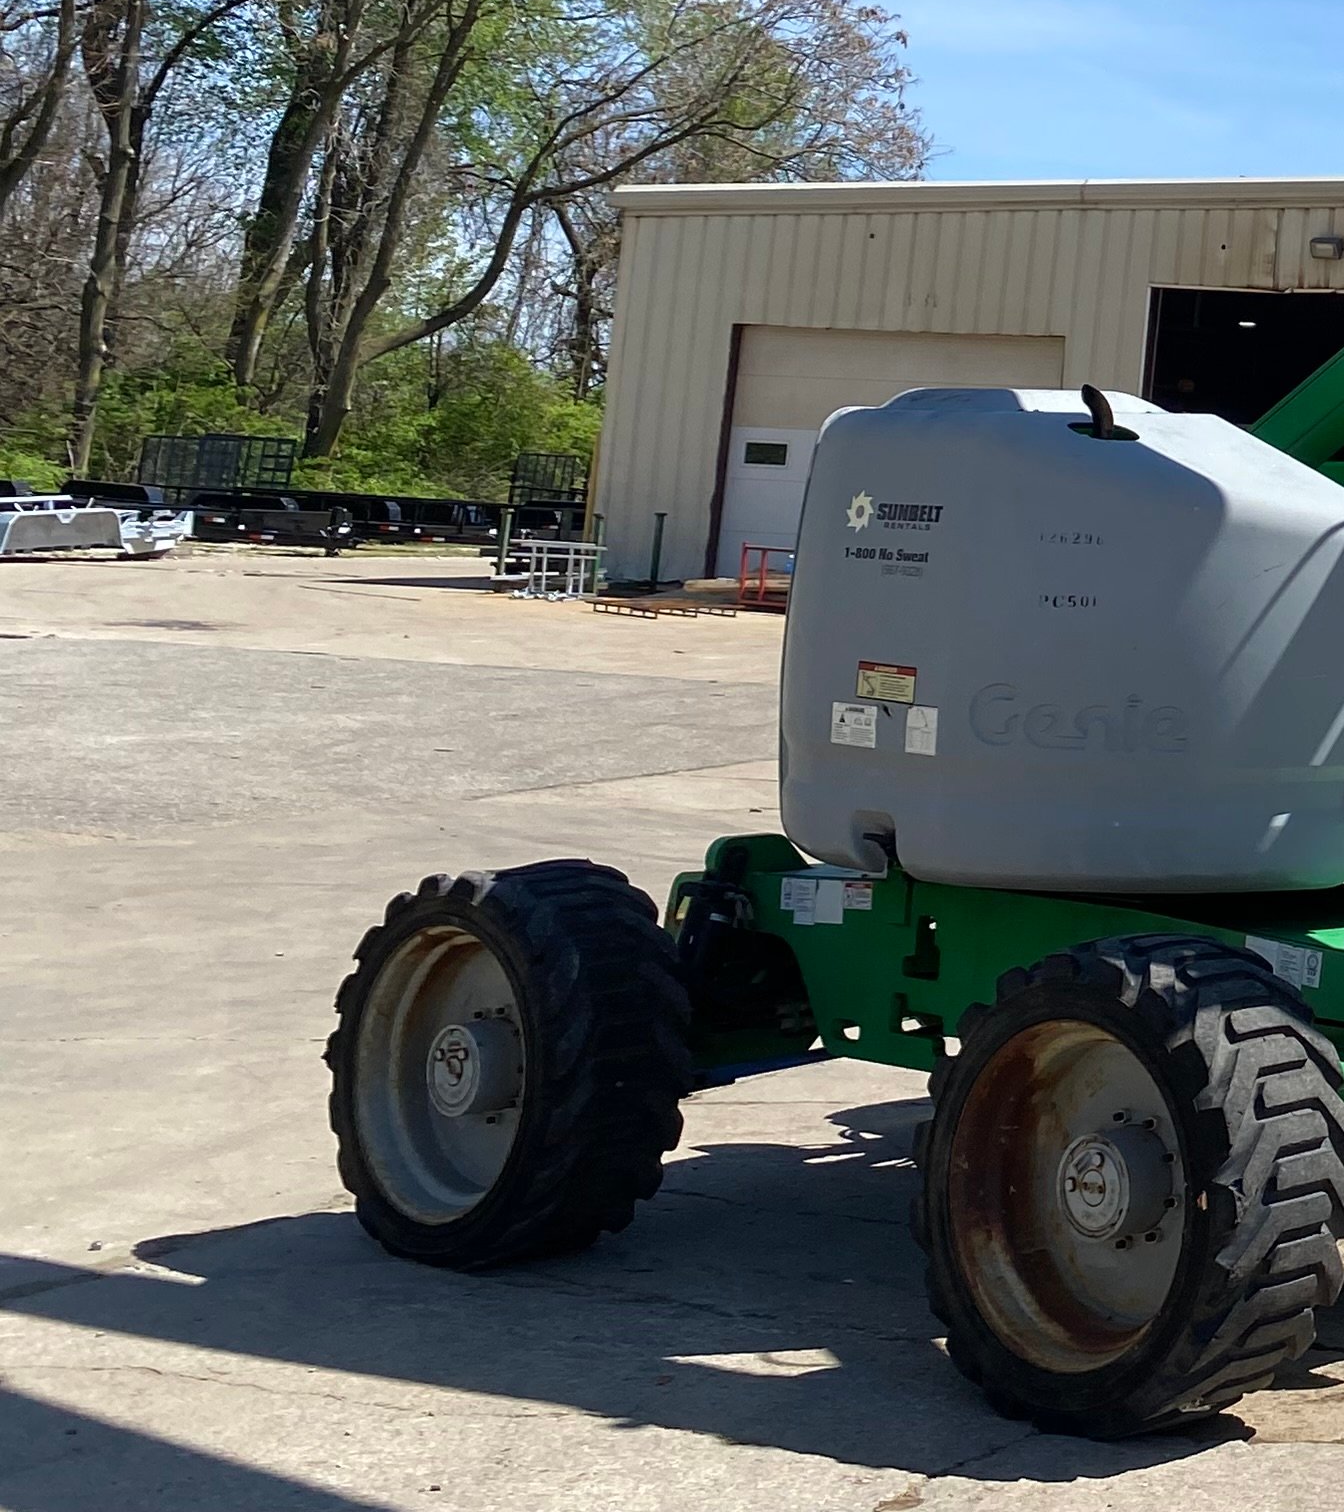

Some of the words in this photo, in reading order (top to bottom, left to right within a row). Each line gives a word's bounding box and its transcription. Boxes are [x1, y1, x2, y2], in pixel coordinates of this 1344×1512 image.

[877, 503, 943, 523] SUNBELT
[883, 521, 930, 531] RENTALS
[844, 547, 876, 560] 1-800
[878, 548, 893, 561] No
[895, 549, 929, 563] Sweat
[969, 682, 1189, 754] Genie
